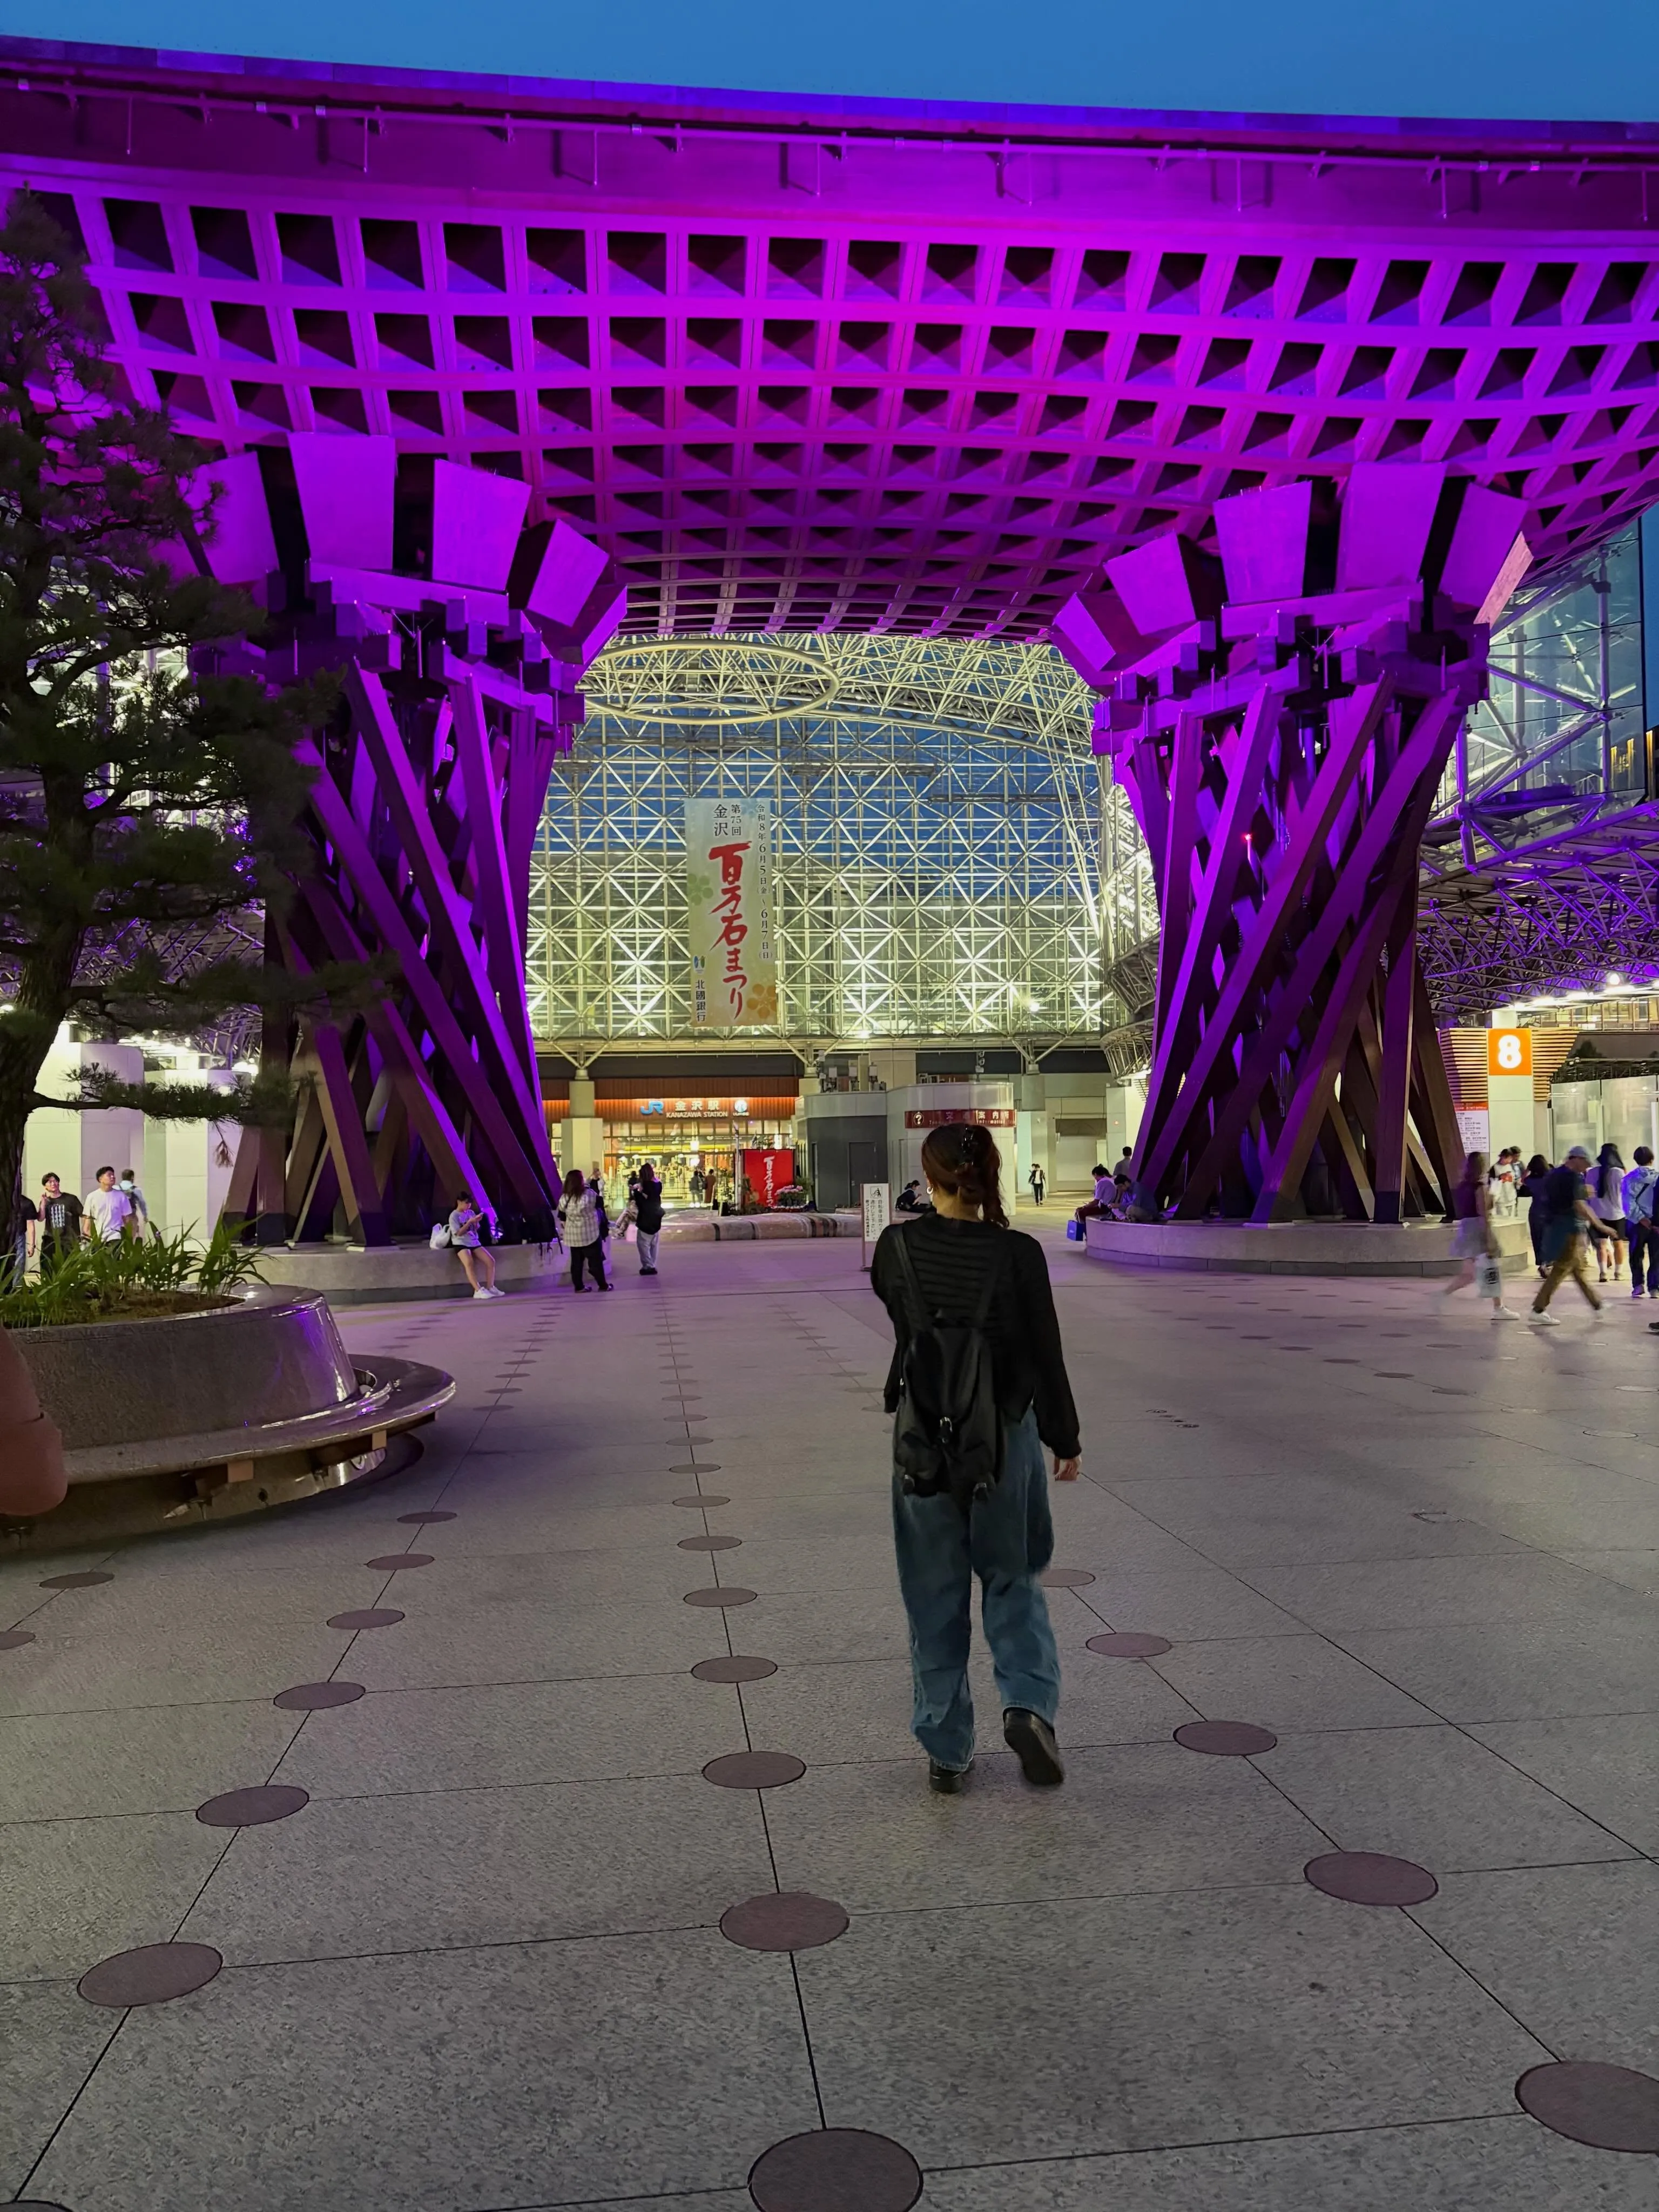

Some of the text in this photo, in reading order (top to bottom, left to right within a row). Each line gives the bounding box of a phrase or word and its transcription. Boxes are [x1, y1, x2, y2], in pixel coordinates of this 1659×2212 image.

[713, 804, 729, 837] 金沢
[731, 804, 741, 836] 第75回
[709, 841, 752, 1019] 百万石まつり
[695, 980, 706, 1022] 北國銀行
[1498, 1034, 1522, 1069] 8
[640, 1101, 664, 1115] JR
[675, 1100, 720, 1111] 金沢駅
[763, 1156, 774, 1207] 百万石まつ
